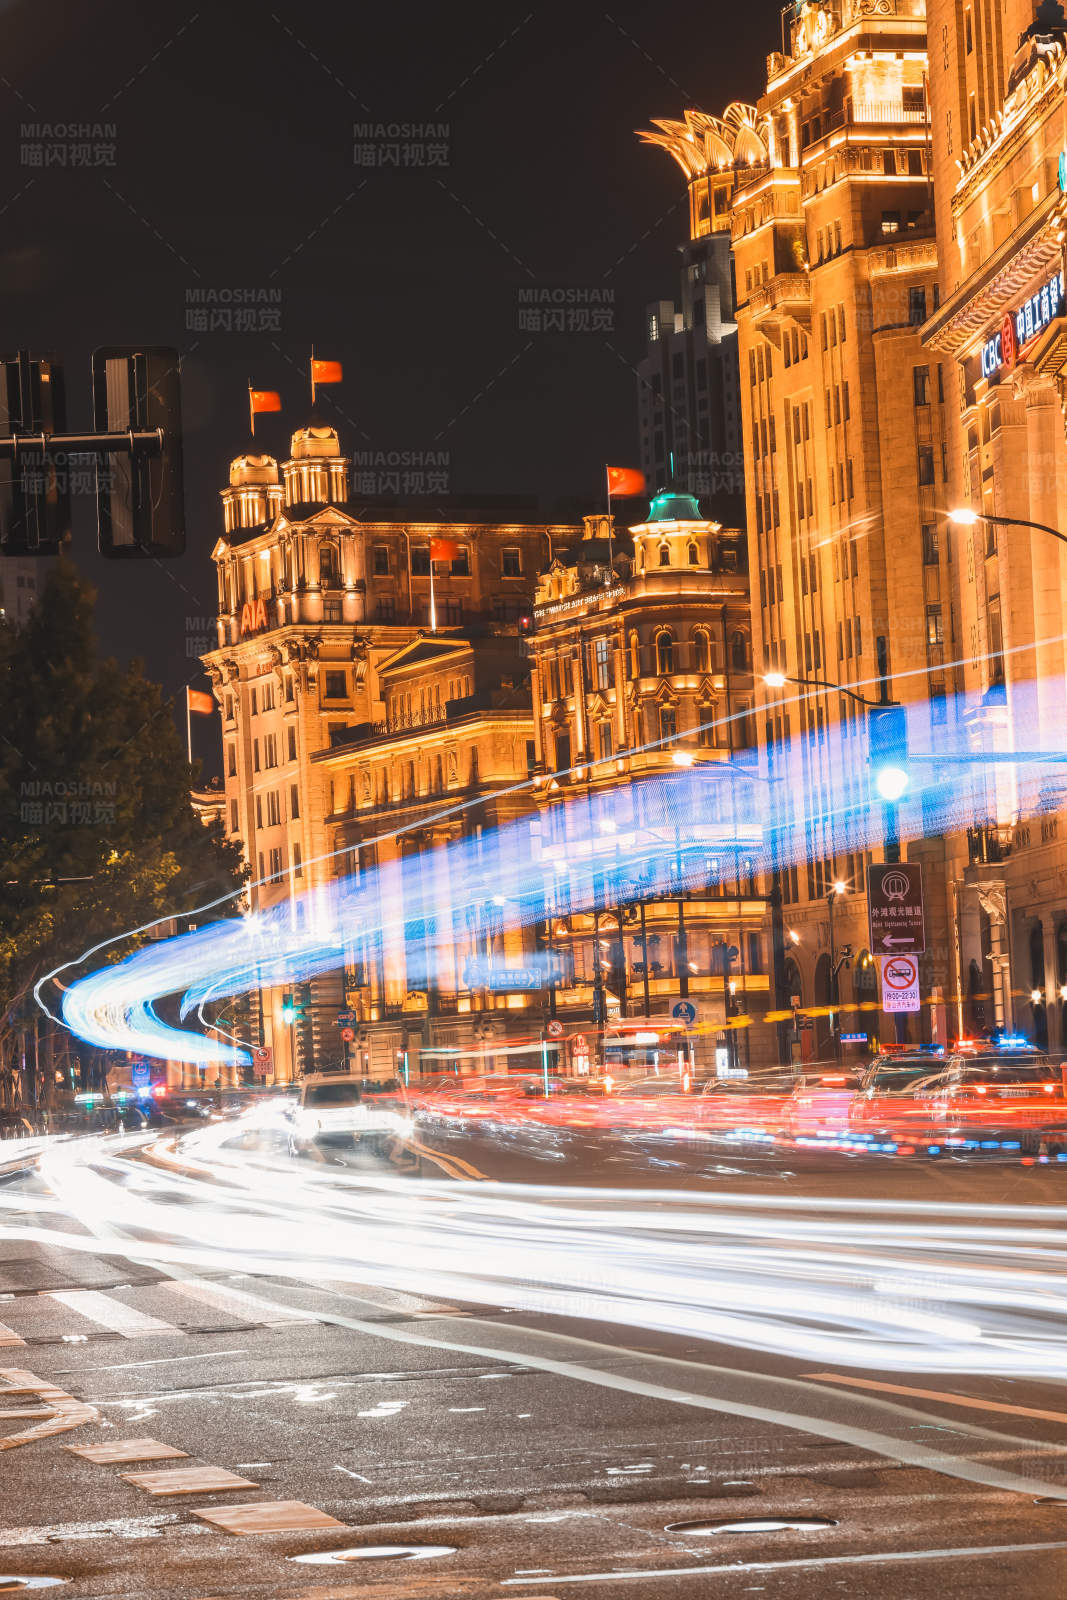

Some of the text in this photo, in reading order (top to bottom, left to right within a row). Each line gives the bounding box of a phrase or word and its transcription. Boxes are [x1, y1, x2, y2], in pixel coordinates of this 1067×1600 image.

[981, 334, 1002, 378] ICBC
[241, 599, 267, 636] AIA
[872, 906, 921, 917] 外滩观光隧道
